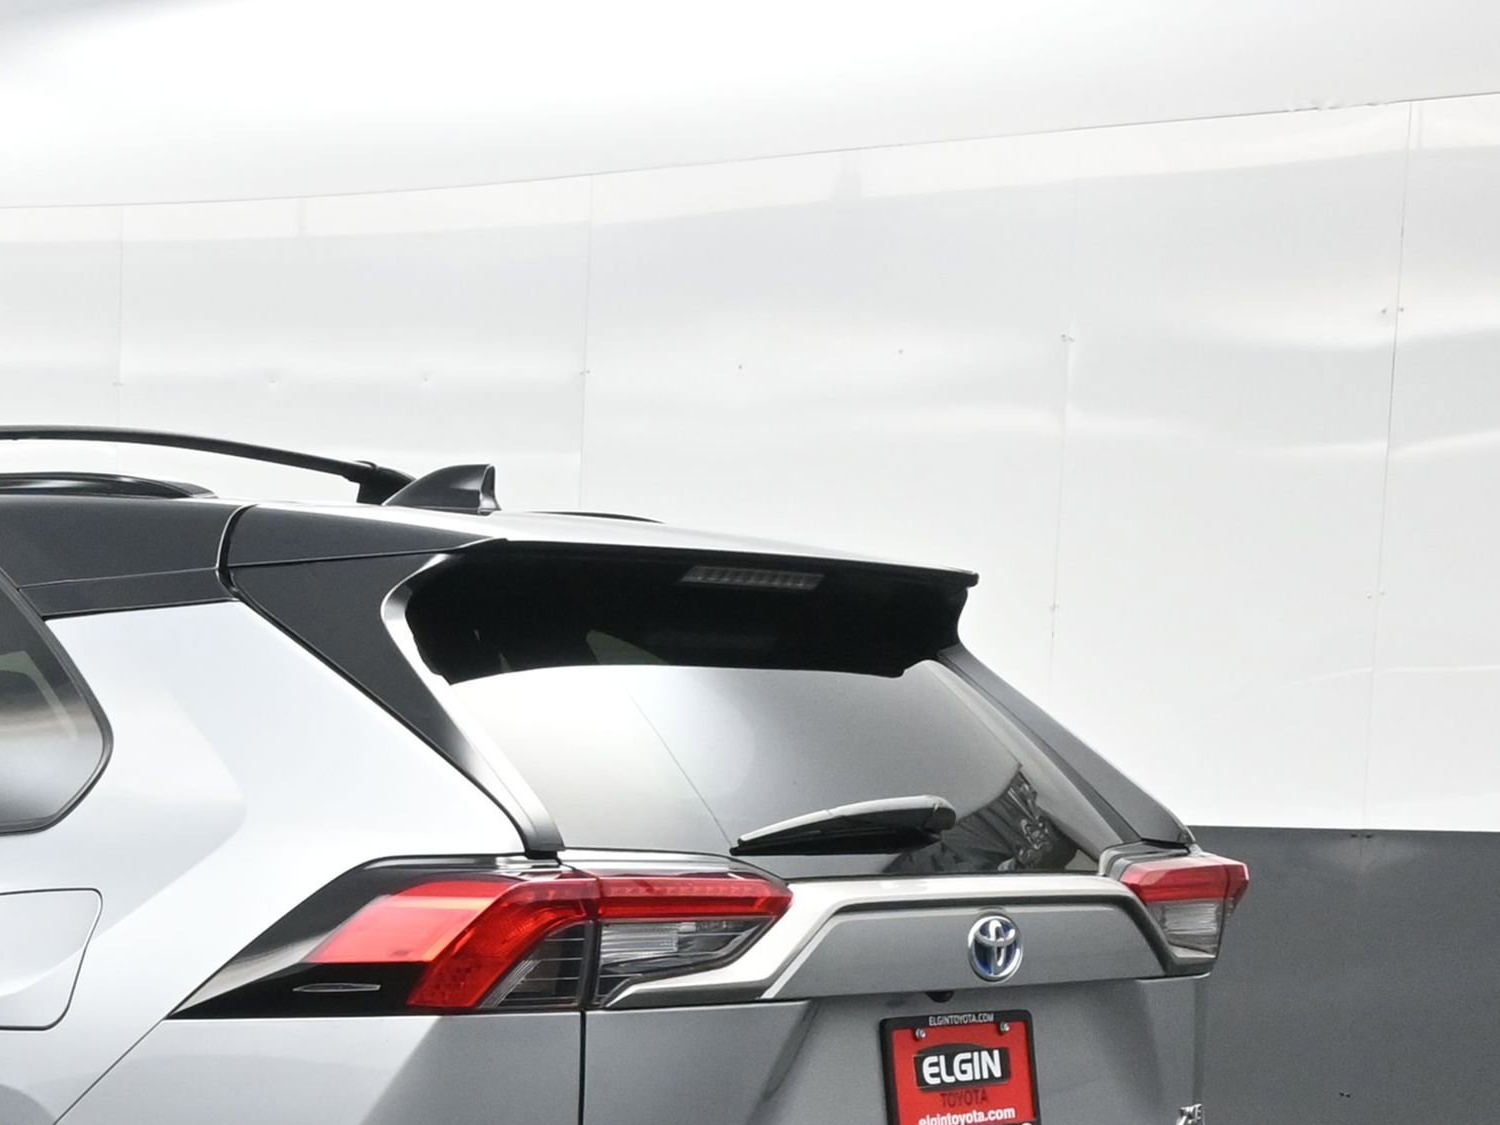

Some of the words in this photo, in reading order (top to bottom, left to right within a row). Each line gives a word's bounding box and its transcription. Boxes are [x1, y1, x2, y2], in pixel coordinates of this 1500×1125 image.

[929, 1013, 994, 1026] ELGINTOYOTA.COM
[922, 1049, 1002, 1085] ELGIN
[940, 1088, 989, 1108] TOYOTA
